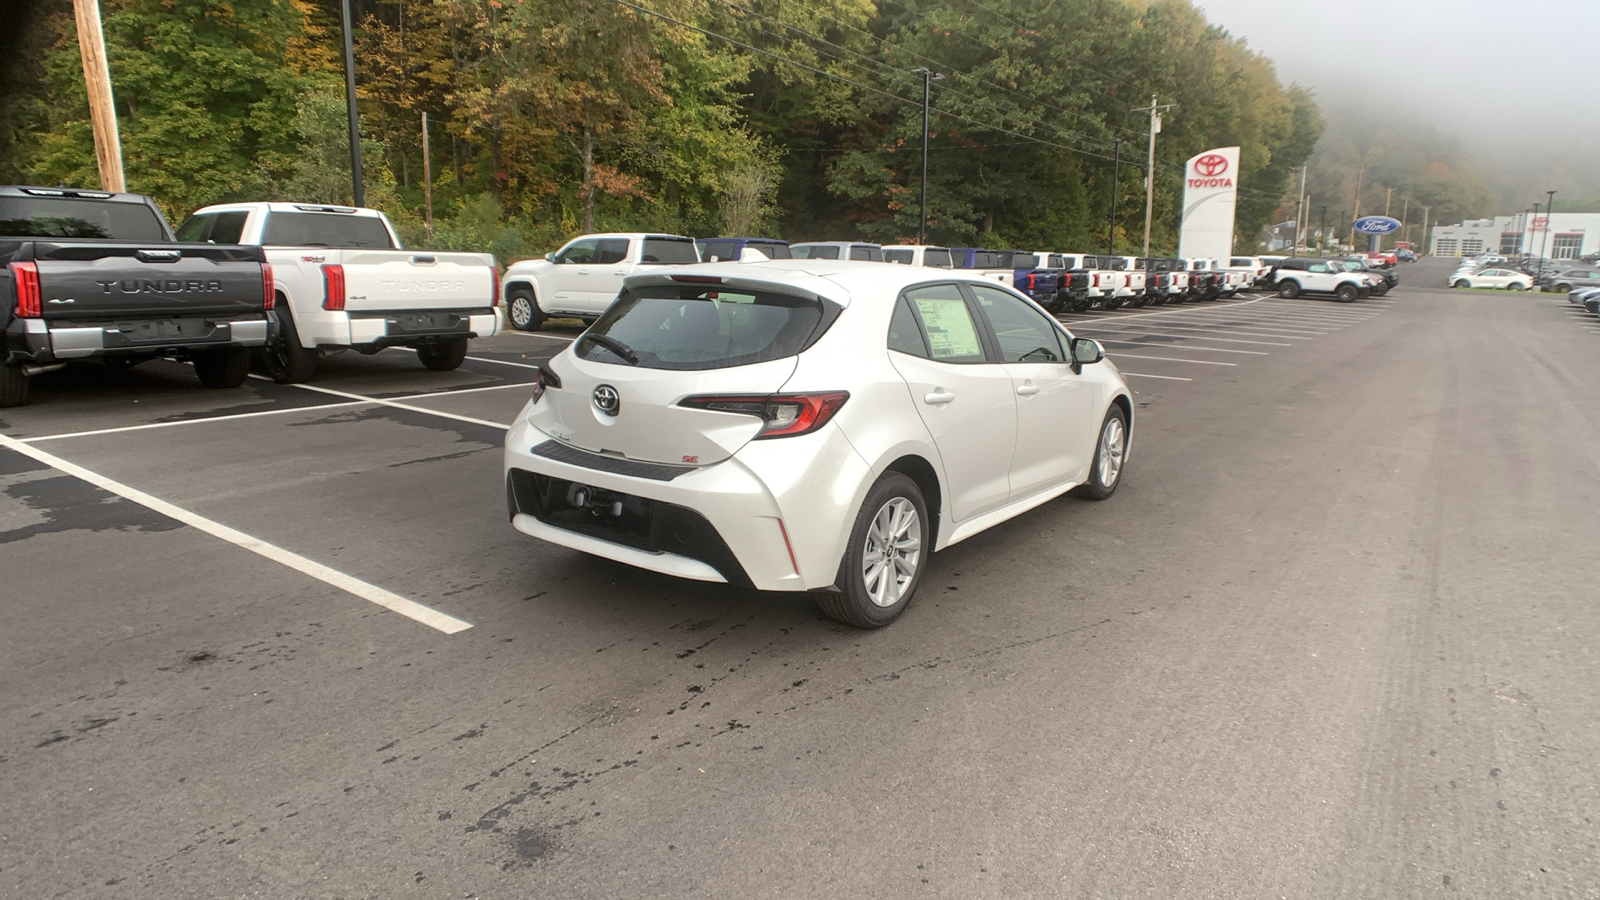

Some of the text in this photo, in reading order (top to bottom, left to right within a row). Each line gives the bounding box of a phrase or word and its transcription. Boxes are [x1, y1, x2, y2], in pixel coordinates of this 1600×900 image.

[1187, 178, 1232, 187] TOYOTA
[1362, 220, 1391, 231] Ford
[95, 279, 224, 294] TUNDRA
[380, 280, 466, 292] TUNDRA
[681, 455, 699, 463] SE
